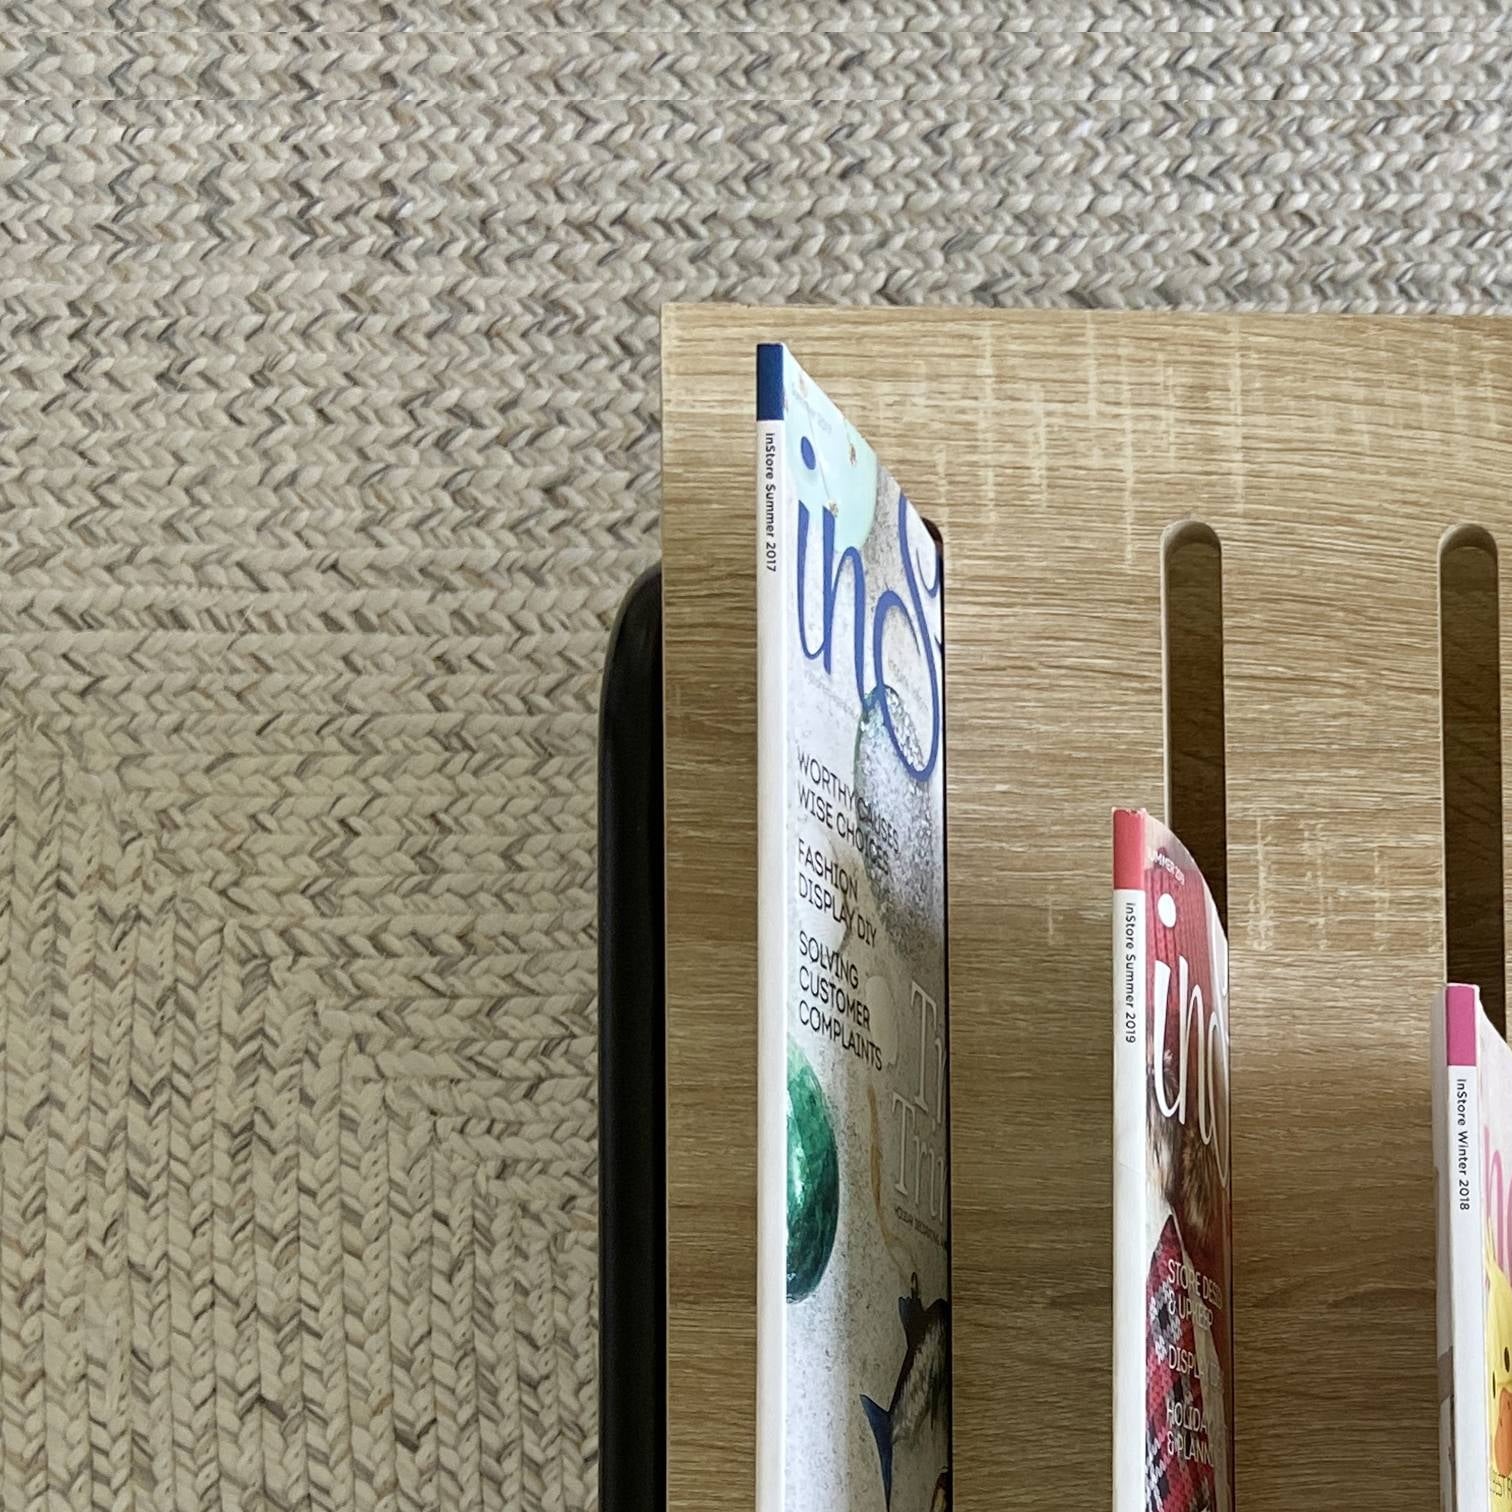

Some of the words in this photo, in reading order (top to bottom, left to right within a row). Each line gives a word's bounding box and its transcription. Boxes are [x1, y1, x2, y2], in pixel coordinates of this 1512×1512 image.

[765, 433, 775, 481] inStore
[766, 484, 776, 538] Summer
[766, 541, 777, 572] 2017
[798, 753, 856, 811] WORTHY
[856, 798, 900, 853] CAUSES
[798, 786, 834, 830] WISE
[836, 811, 890, 876] CHOICES
[798, 839, 859, 901] FASHION
[798, 873, 856, 932] DISPLAY
[857, 914, 878, 949] DIY
[798, 929, 860, 989] SOLVING
[1125, 951, 1136, 1007] Summer
[798, 965, 871, 1033] CUSTOMER
[1125, 1010, 1136, 1043] 2019
[798, 999, 883, 1072] COMPLAINTS
[1457, 1131, 1469, 1176] Winter
[1458, 1178, 1470, 1211] 2018
[1168, 1258, 1201, 1297] STORE
